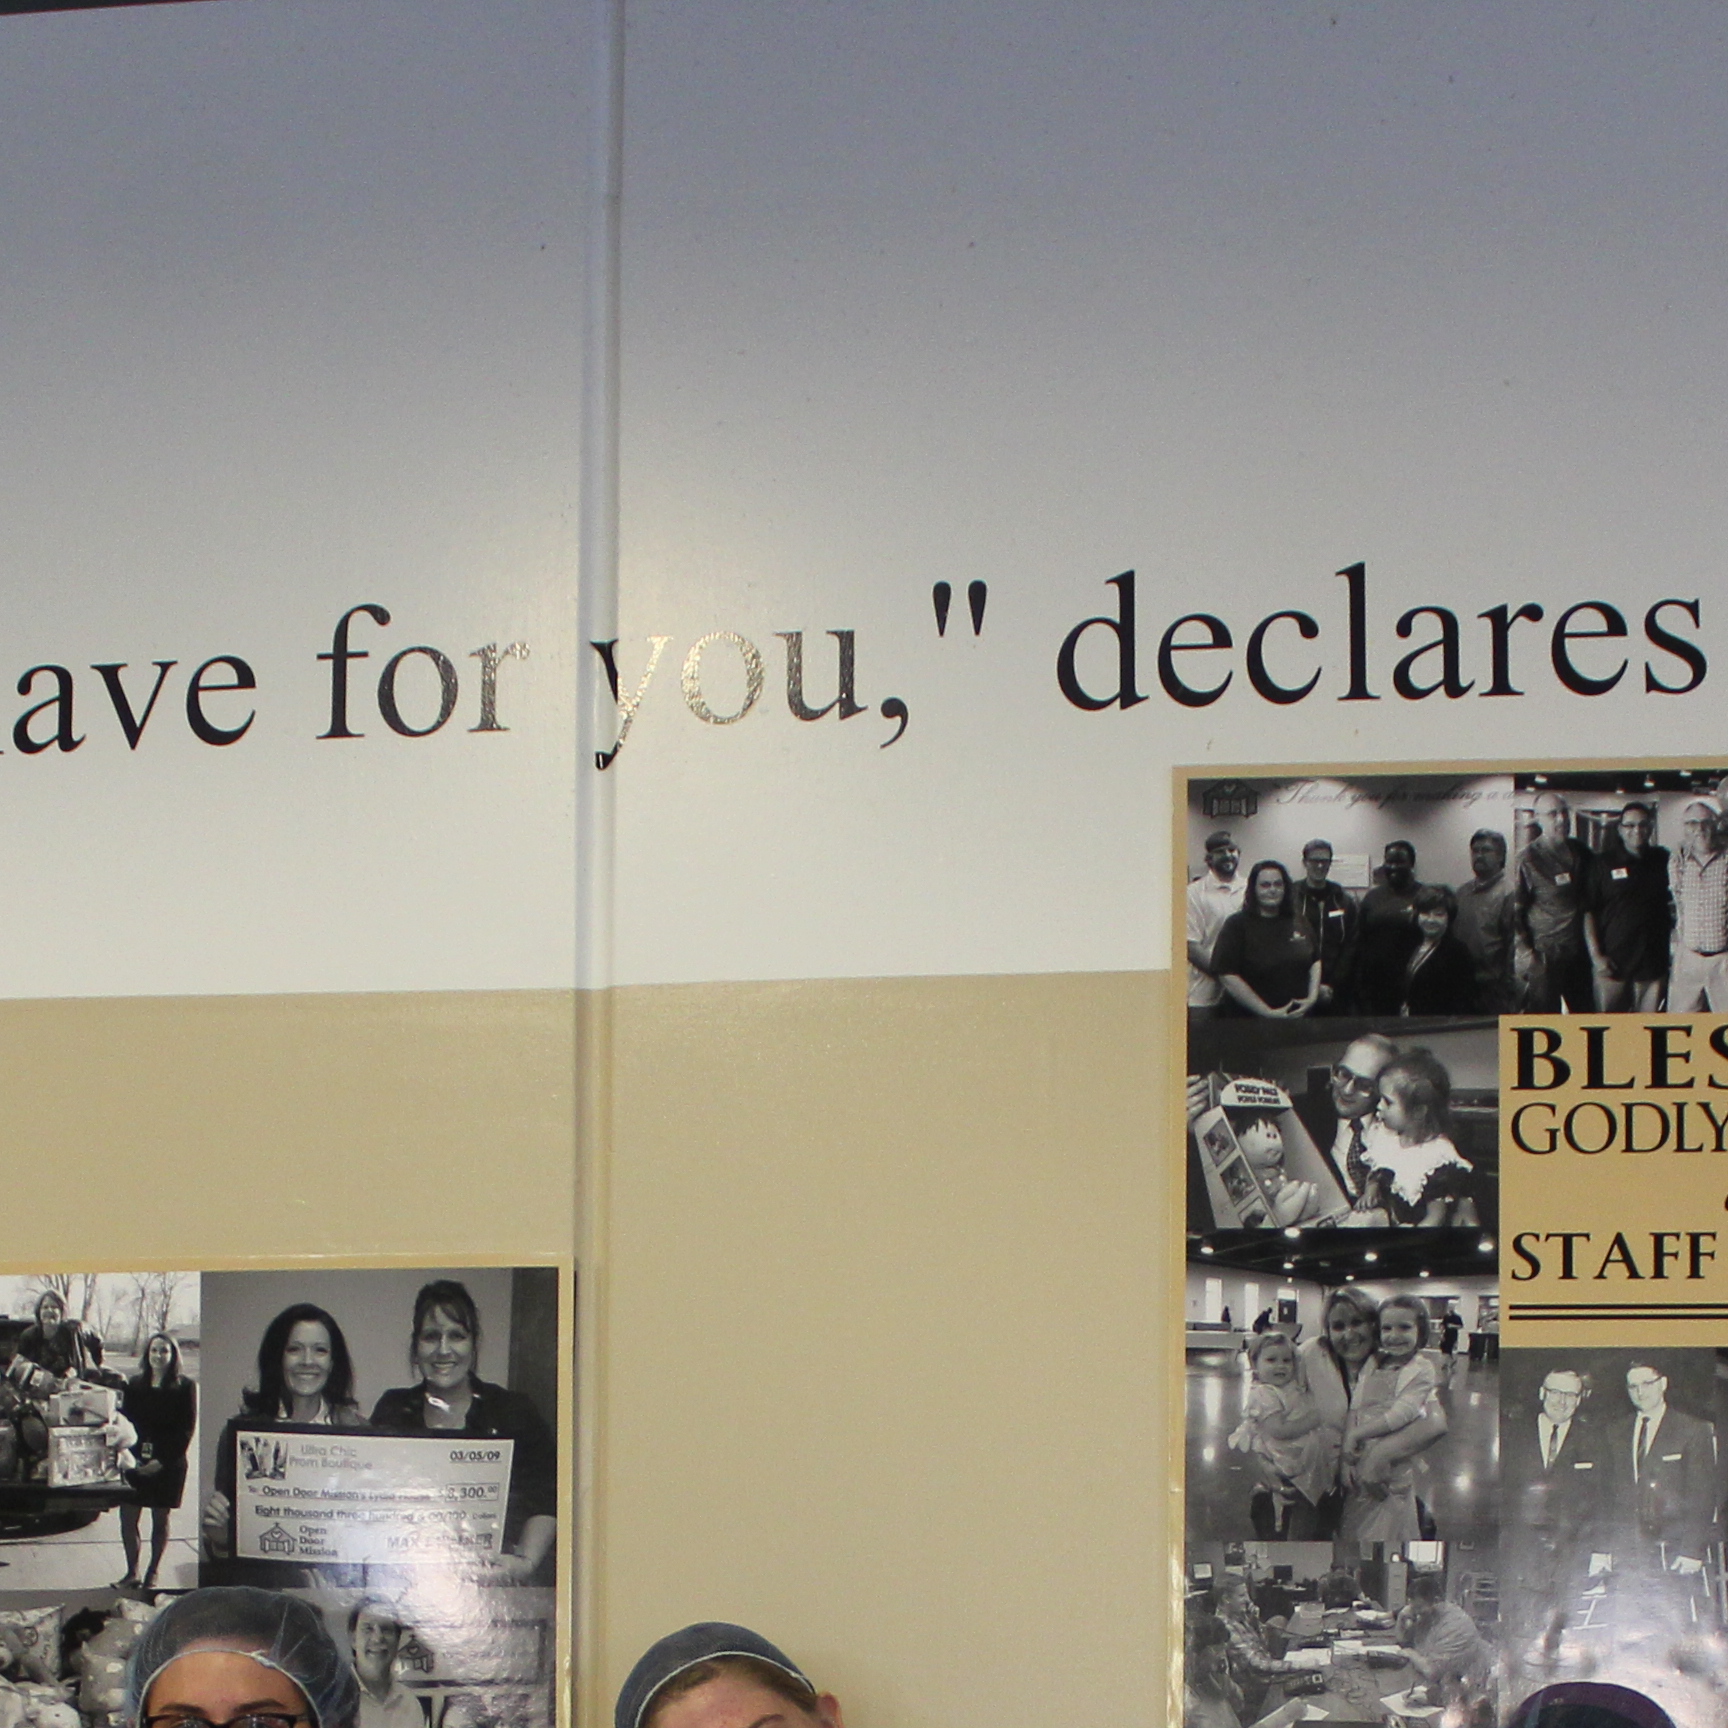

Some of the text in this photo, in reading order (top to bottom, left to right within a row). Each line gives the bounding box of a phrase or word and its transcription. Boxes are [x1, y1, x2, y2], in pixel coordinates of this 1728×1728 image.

[315, 604, 530, 740] for
[590, 580, 990, 771] you,"
[1057, 562, 1710, 712] declares
[1510, 1232, 1718, 1282] STAFF
[450, 1450, 502, 1461] 03/05/09
[262, 1485, 290, 1497] Open
[283, 1507, 333, 1519] thousand
[299, 1525, 327, 1536] Open
[299, 1537, 325, 1546] Door
